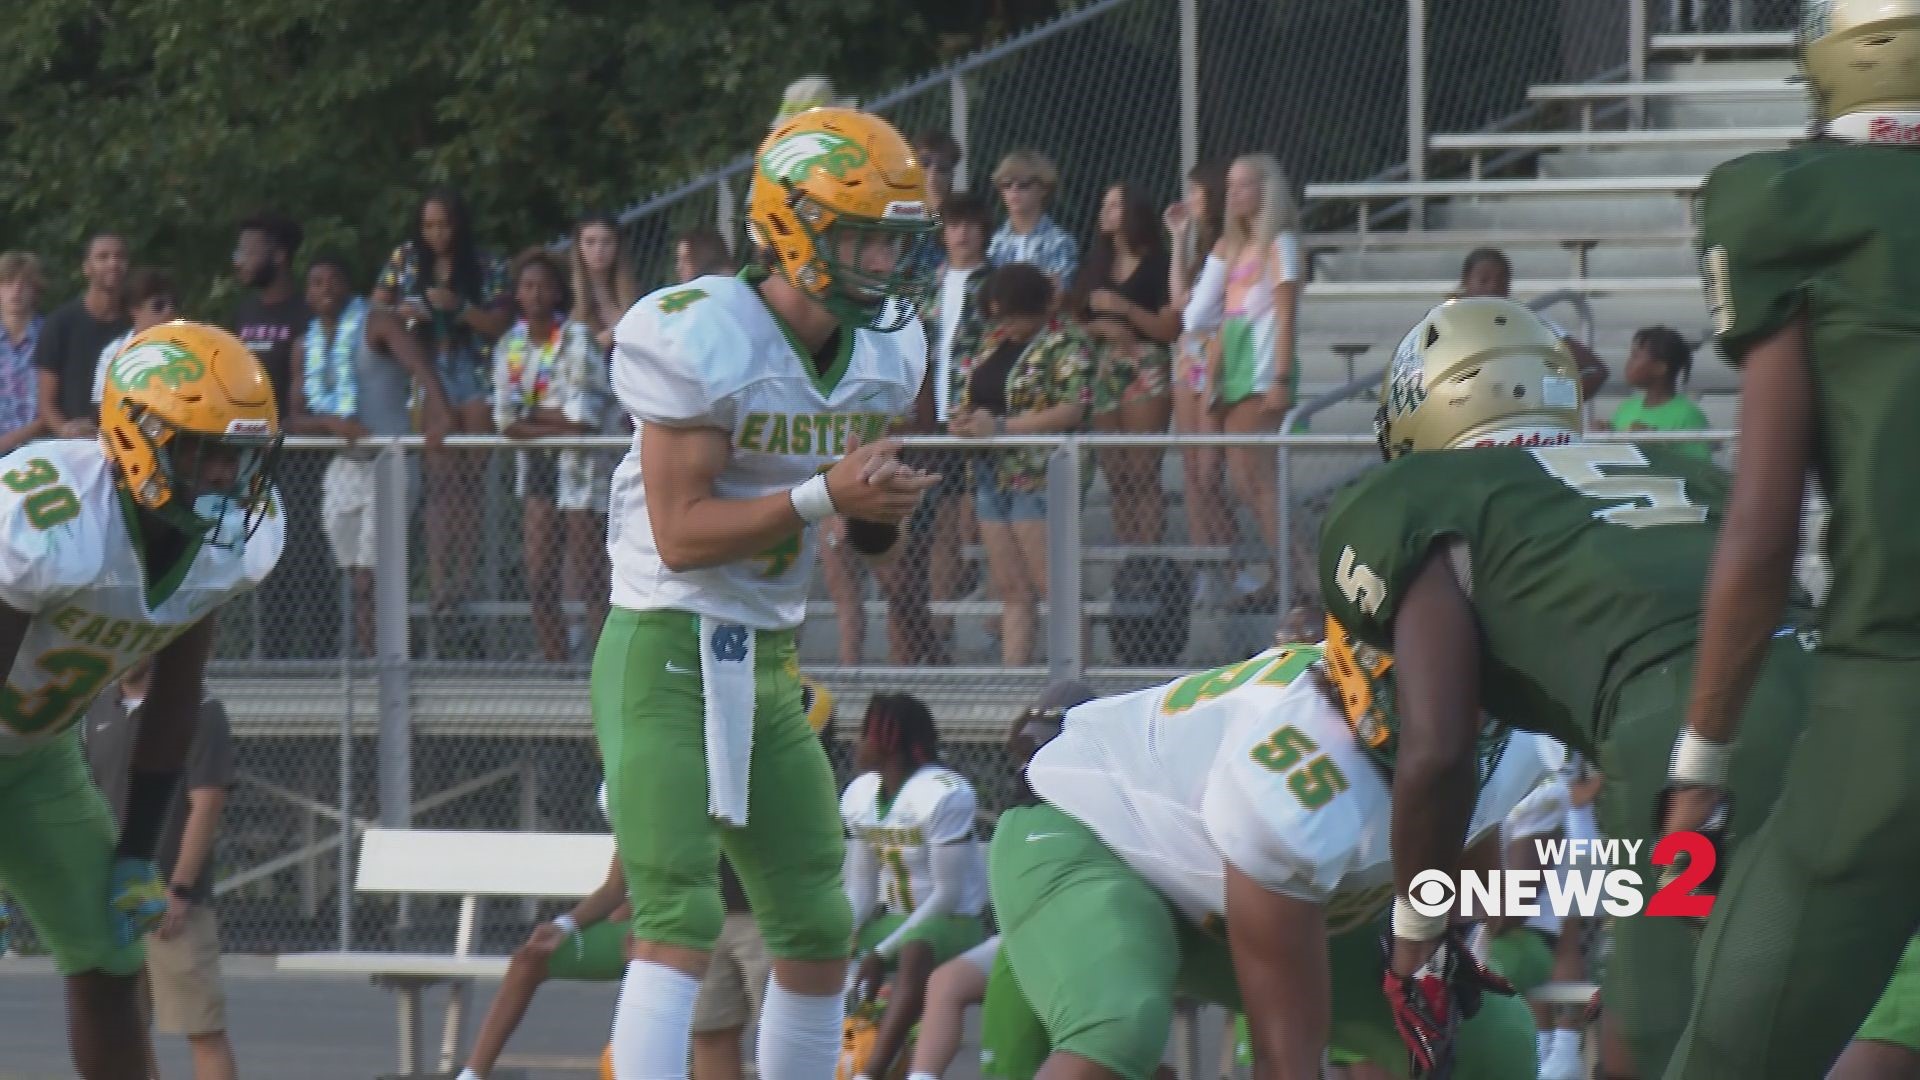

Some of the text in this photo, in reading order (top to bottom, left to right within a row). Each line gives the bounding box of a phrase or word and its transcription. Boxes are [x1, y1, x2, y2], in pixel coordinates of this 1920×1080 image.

[1, 457, 81, 530] 30
[1526, 443, 1709, 529] 5
[1335, 544, 1387, 616] 5
[1249, 724, 1350, 810] 55
